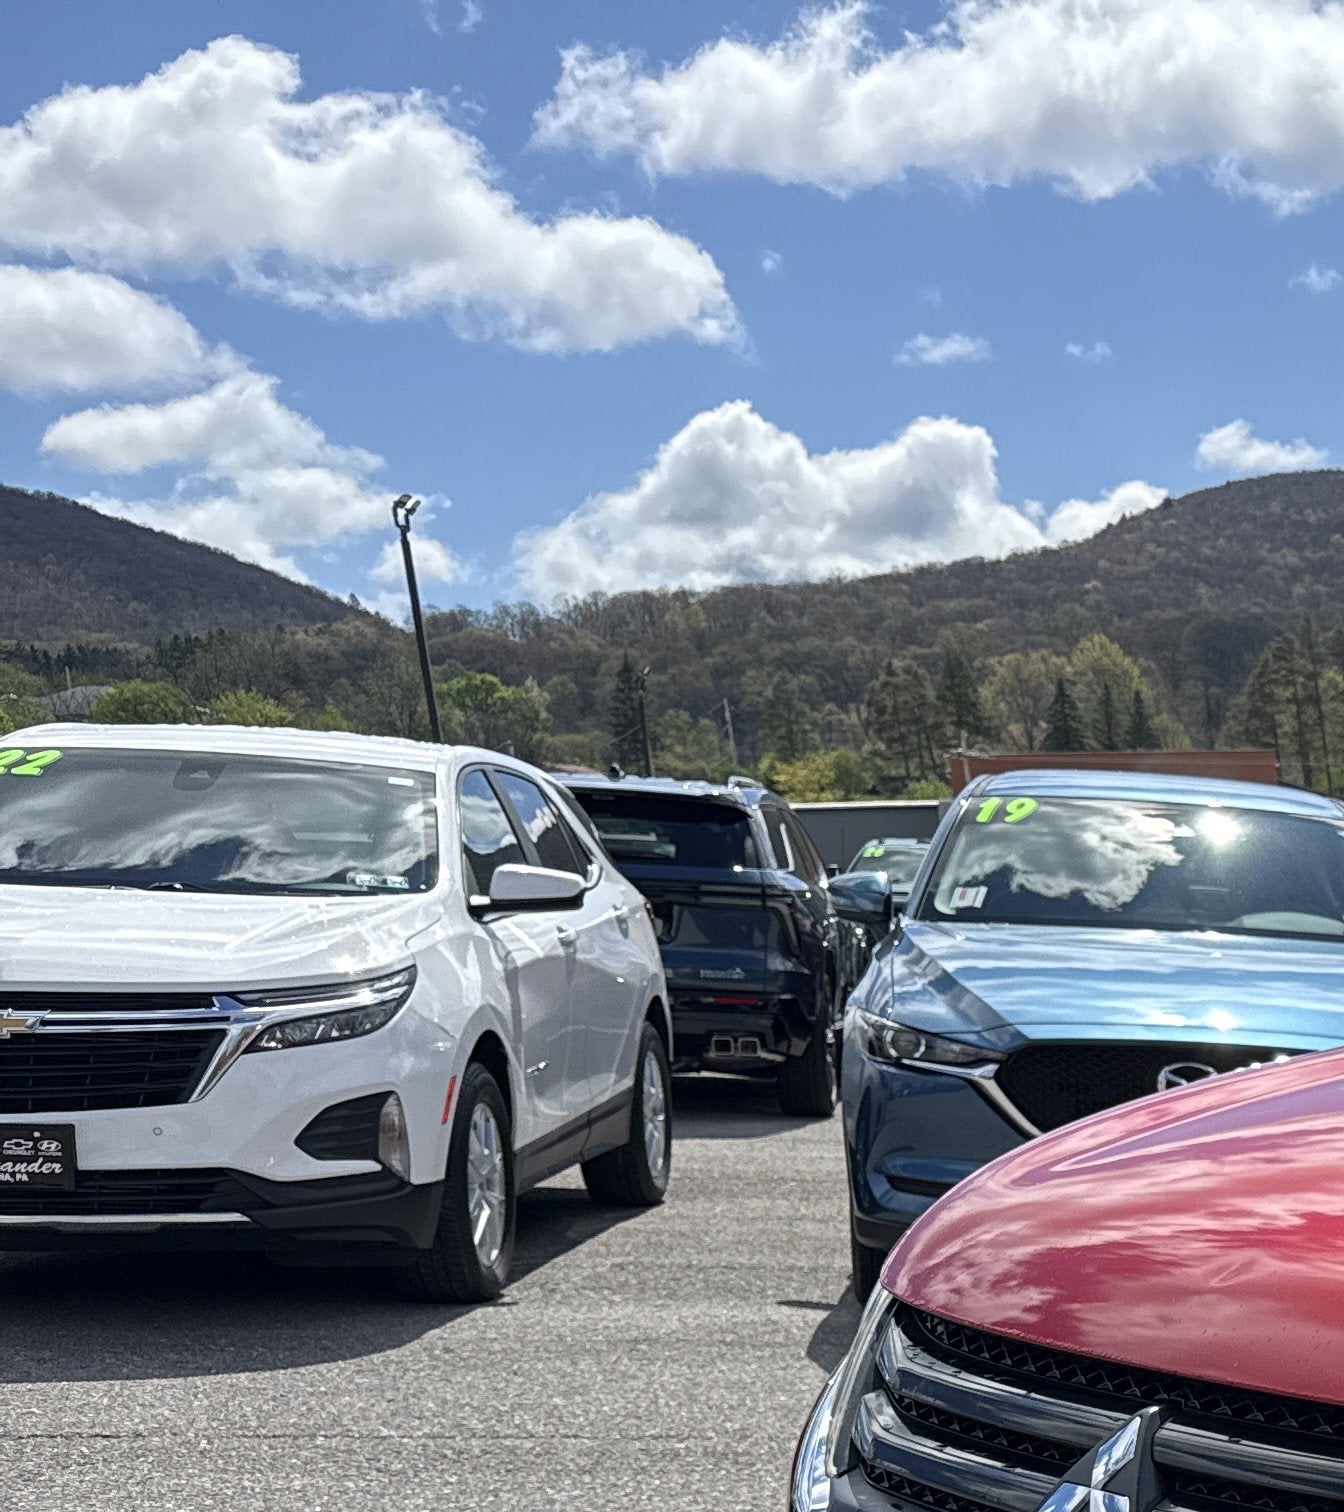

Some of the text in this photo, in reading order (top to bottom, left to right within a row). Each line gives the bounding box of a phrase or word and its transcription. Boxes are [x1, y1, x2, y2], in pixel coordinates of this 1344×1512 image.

[975, 797, 1038, 824] 19
[0, 1156, 64, 1174] ander
[16, 1173, 29, 1182] PA
